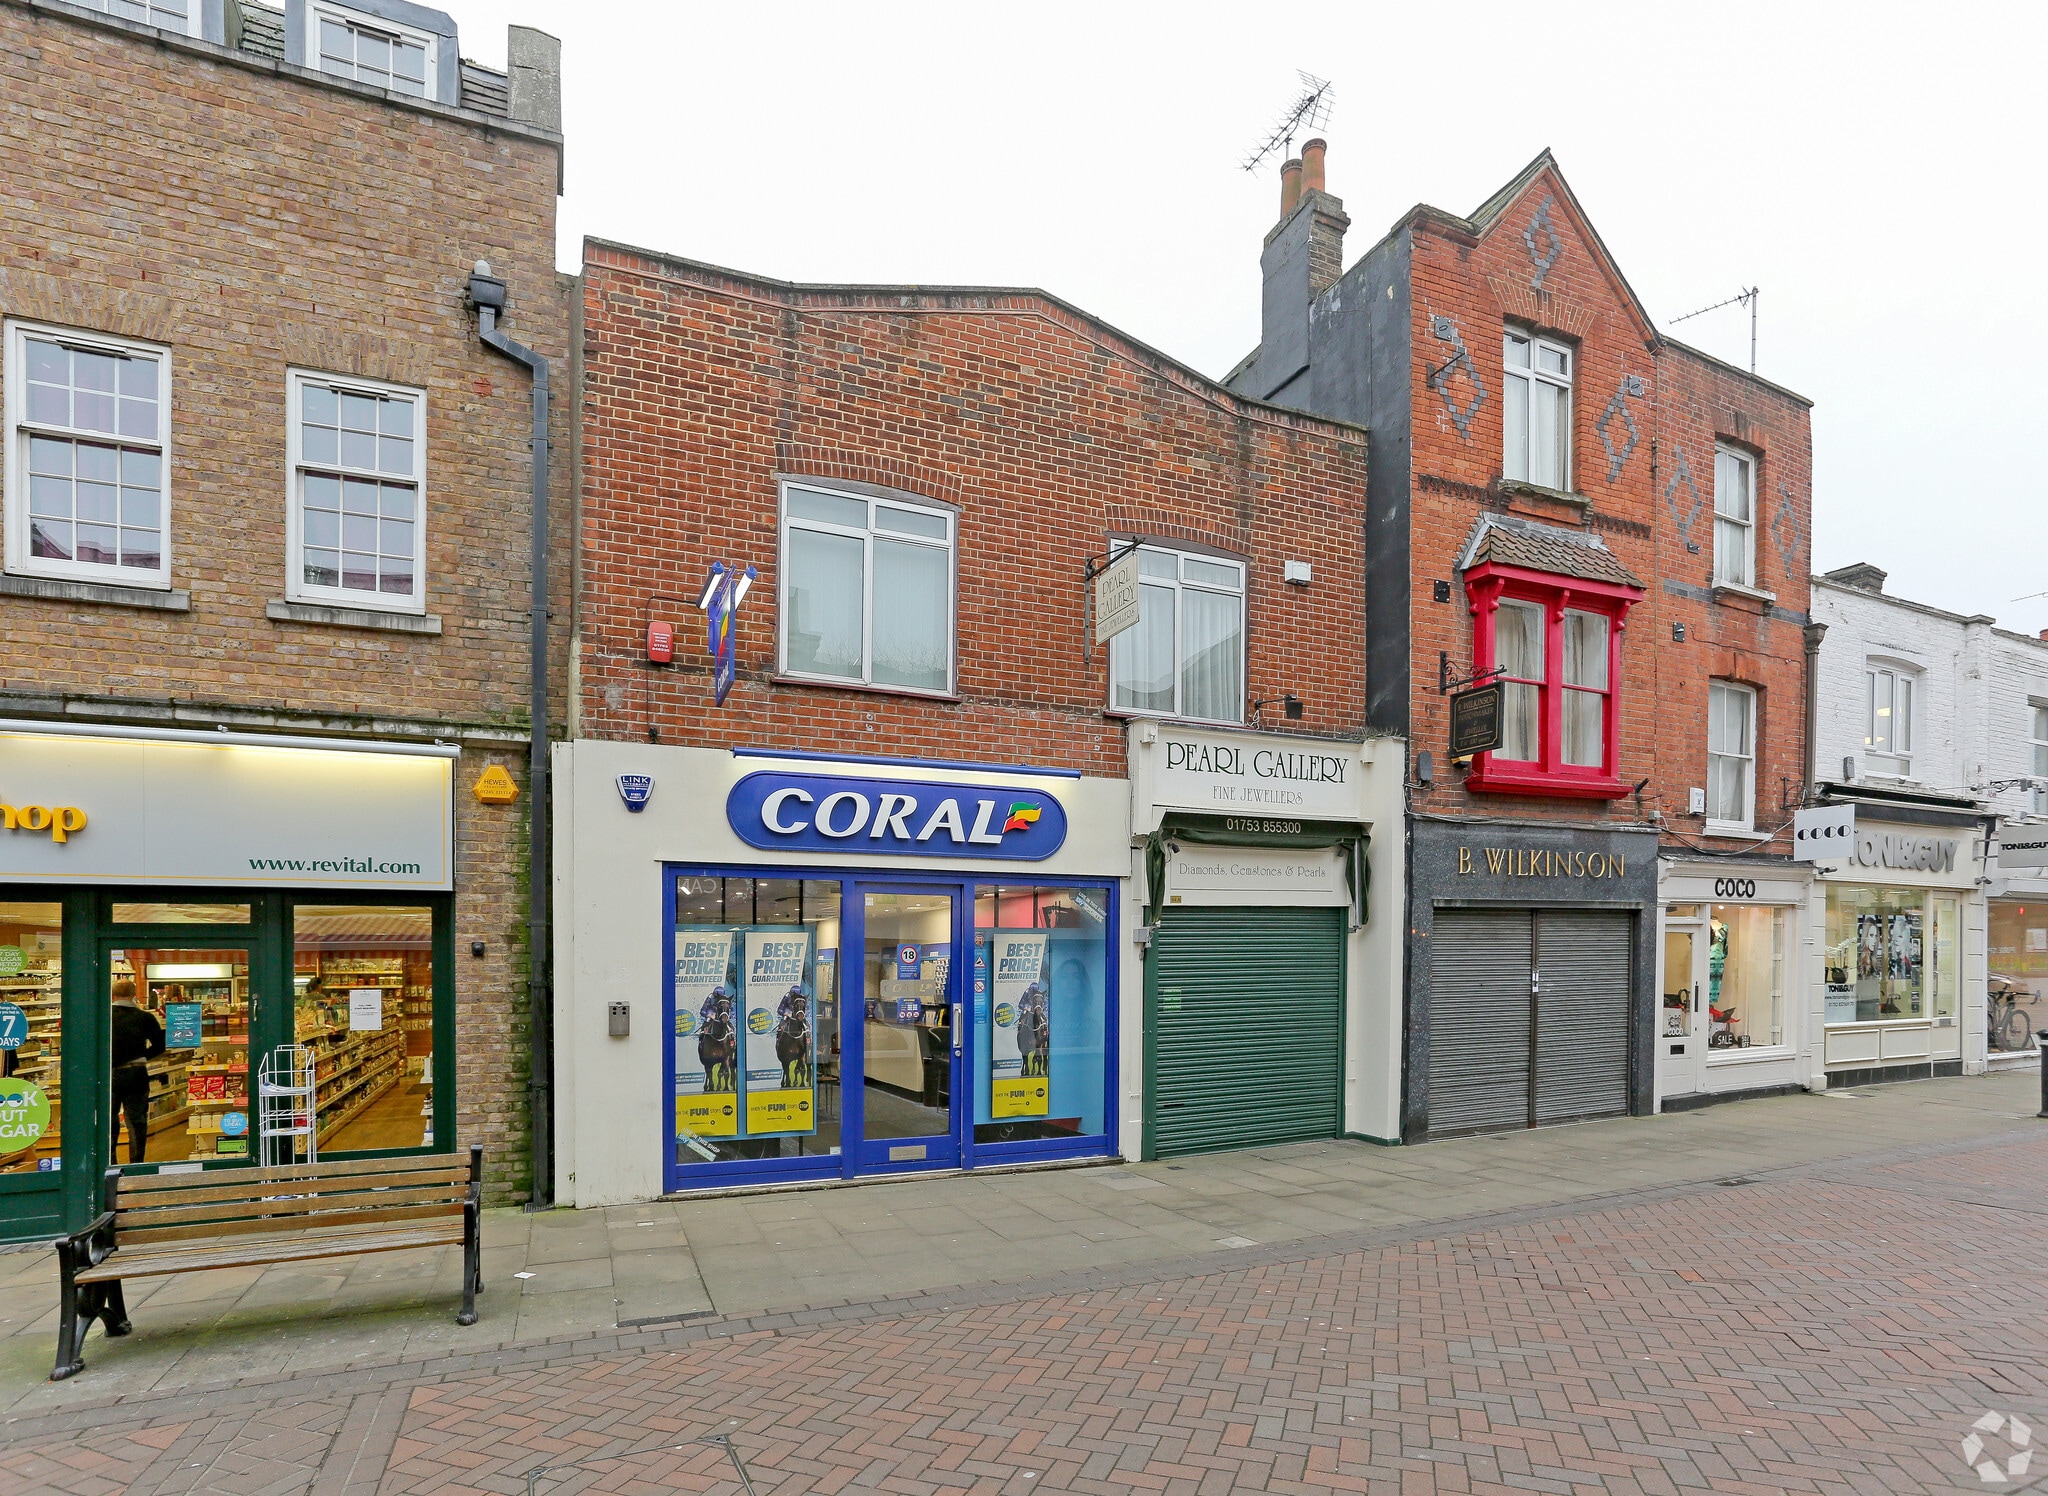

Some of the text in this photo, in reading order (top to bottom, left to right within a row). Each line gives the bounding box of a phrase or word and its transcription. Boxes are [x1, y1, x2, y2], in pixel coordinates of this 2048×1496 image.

[1102, 567, 1131, 597] PEARL
[1097, 583, 1136, 619] GALLERY
[1166, 742, 1349, 783] PEARL GALLERY
[1213, 785, 1303, 805] FINE JEWELLERS
[761, 788, 1003, 844] CORAL
[1226, 818, 1301, 834] 01753 855300
[1797, 824, 1851, 841] COCO
[249, 857, 421, 874] www.revital.com
[1179, 863, 1326, 877] Diamonds, Gemstones & Pearls
[1458, 847, 1625, 878] B. WILKINSON
[1714, 878, 1756, 899] COCO
[684, 942, 728, 957] BEST
[762, 942, 804, 957] BEST
[903, 951, 915, 960] 18
[1007, 943, 1042, 957] BEST
[676, 959, 726, 975] PRICE
[753, 959, 801, 974] PRICE
[999, 958, 1040, 972] PRICE
[752, 974, 799, 982] GUARANTEED
[1828, 984, 1854, 993] TONI&GUY
[3, 1016, 16, 1037] 7
[1717, 1034, 1733, 1045] SALE
[1010, 1090, 1025, 1098] FUN
[690, 1107, 709, 1116] FUN
[768, 1103, 786, 1112] FUN
